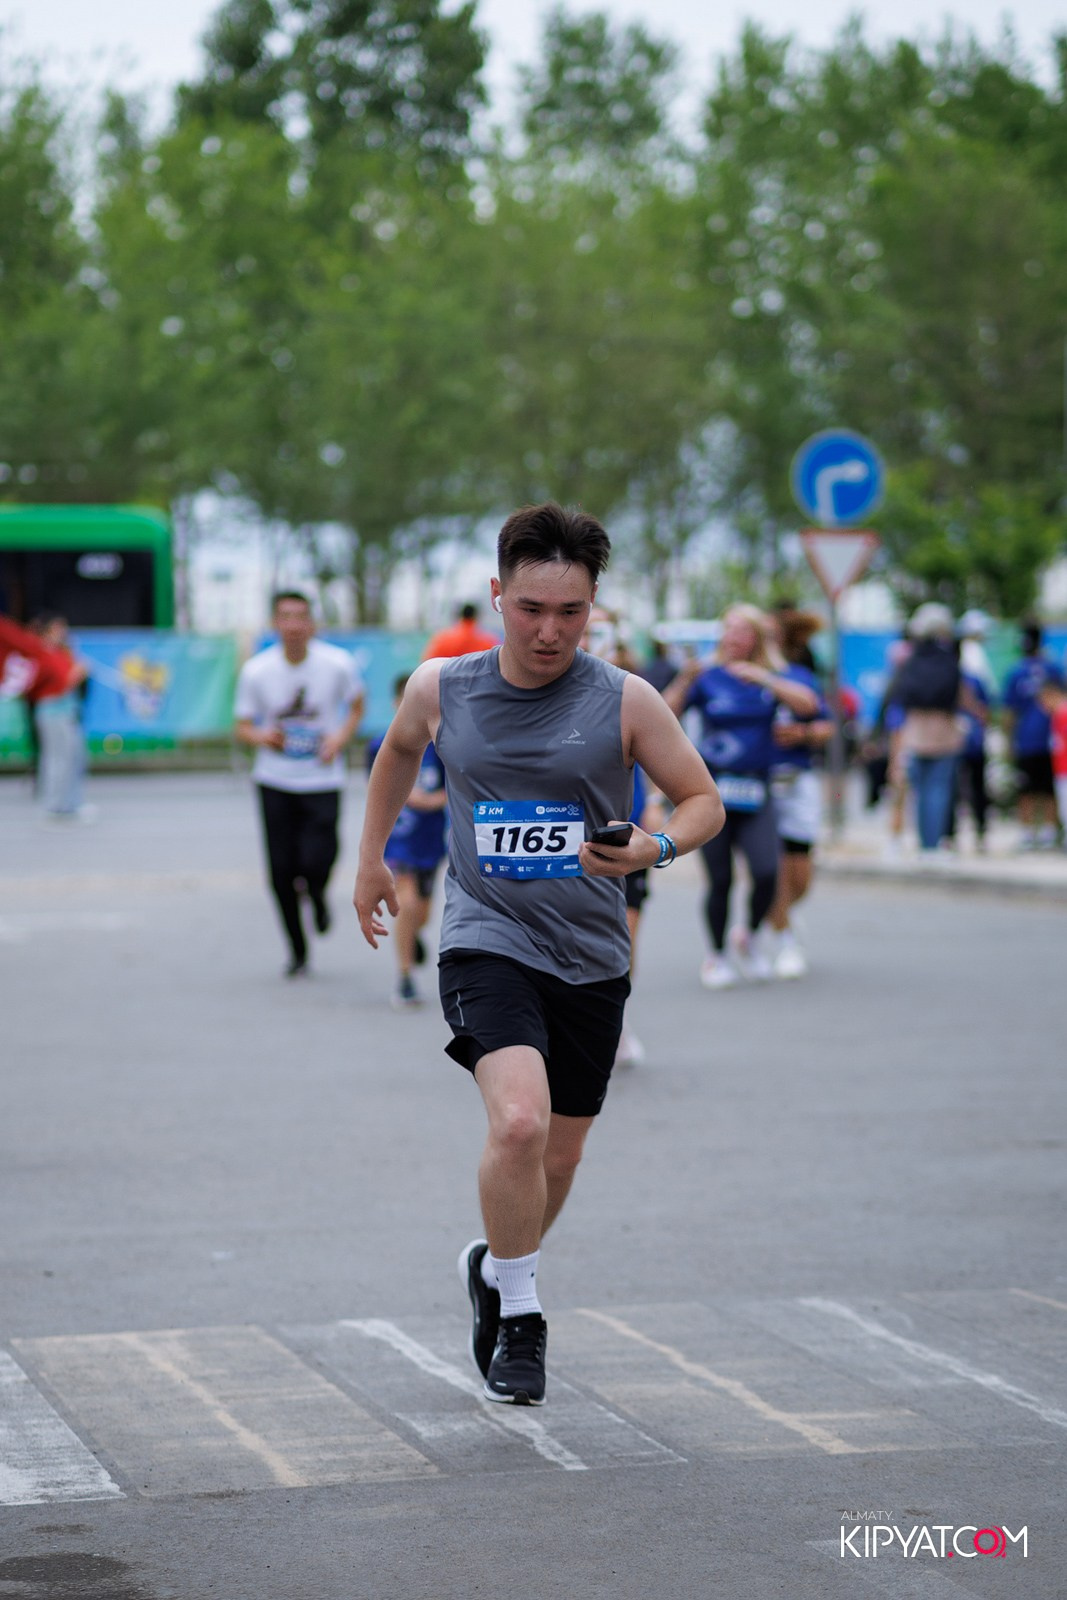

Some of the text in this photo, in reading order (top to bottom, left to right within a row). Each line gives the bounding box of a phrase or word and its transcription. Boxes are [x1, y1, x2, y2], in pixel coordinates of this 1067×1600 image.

[478, 805, 503, 815] 5 KM
[492, 826, 568, 853] 1165
